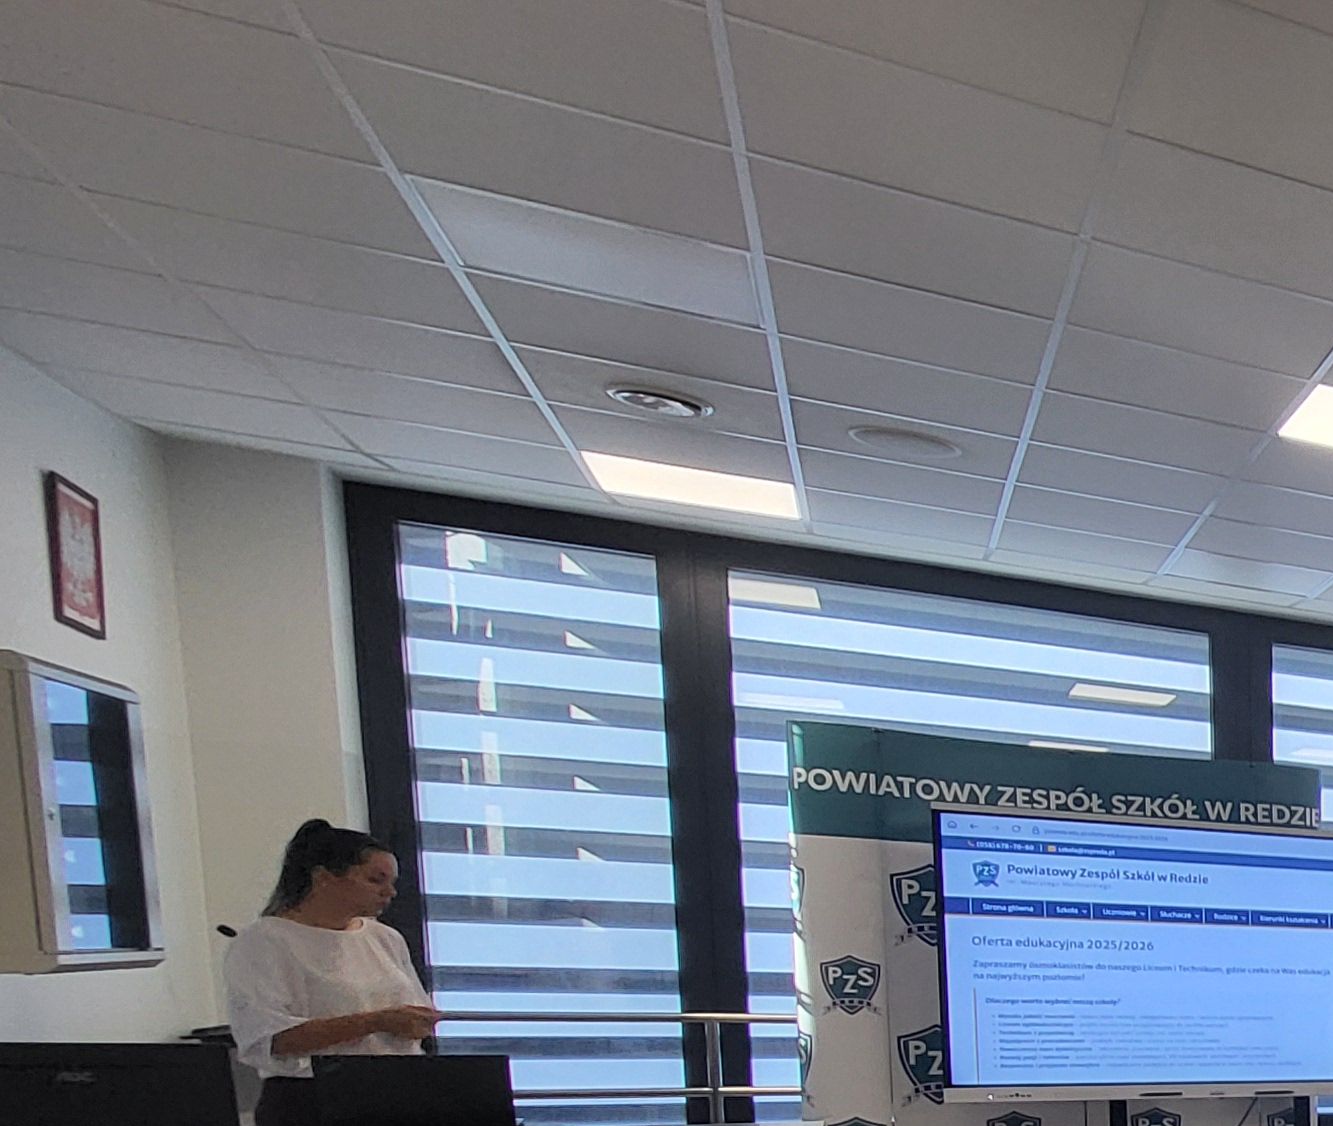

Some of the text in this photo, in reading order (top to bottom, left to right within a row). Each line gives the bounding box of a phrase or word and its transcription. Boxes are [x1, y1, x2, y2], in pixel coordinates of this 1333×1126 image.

[792, 766, 1319, 828] POWIATOWY ZESPÓŁ SZKÓŁ W REDZIE
[976, 864, 997, 875] PZS
[1007, 864, 1209, 885] Powiatowy Zespół Szkół w Redzie
[901, 879, 937, 916] PZ
[972, 936, 1154, 951] Oferta edukacyjna 2025/2026
[828, 966, 874, 993] PZS
[908, 1040, 944, 1075] PZ
